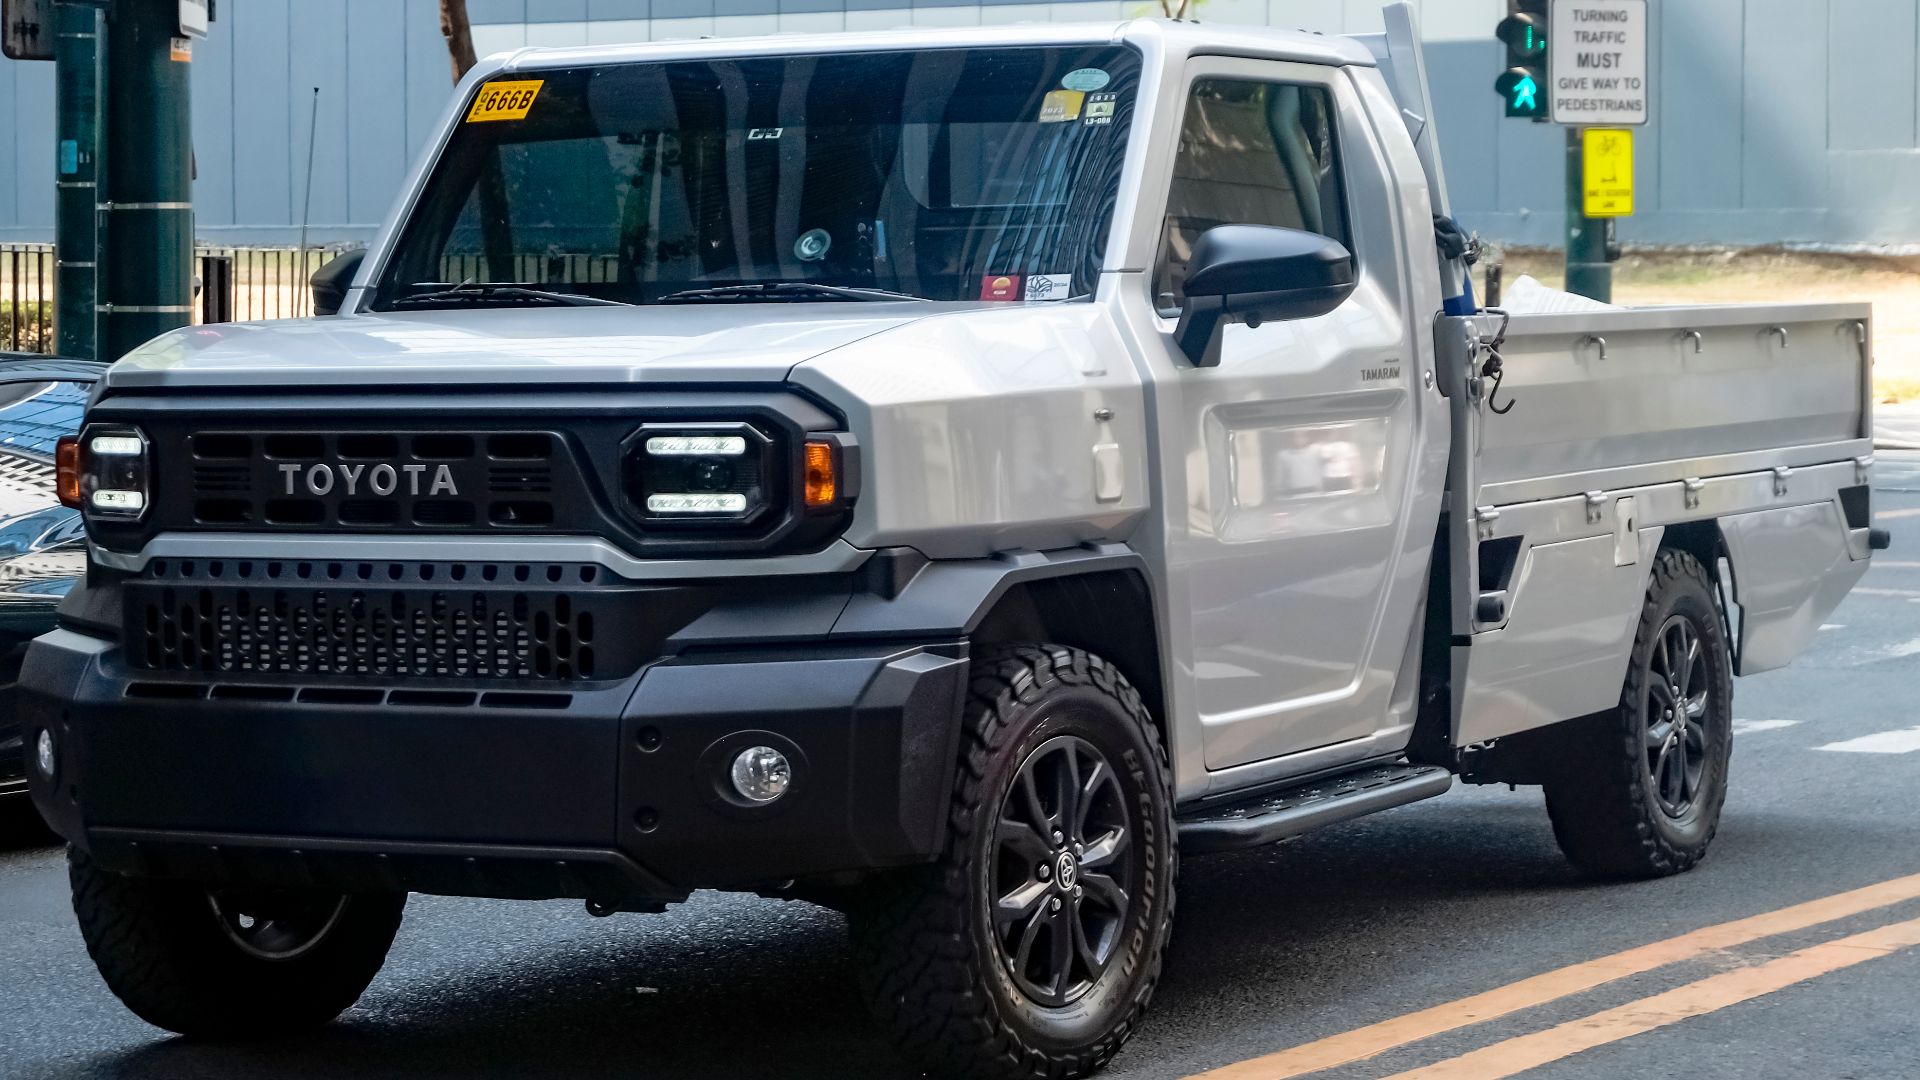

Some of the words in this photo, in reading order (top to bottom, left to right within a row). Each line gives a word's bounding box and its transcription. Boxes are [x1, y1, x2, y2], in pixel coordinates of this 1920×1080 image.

[1572, 9, 1629, 23] TURNING
[1574, 31, 1627, 44] TRAFFIC
[1576, 52, 1622, 68] MUST
[1558, 77, 1589, 90] GIVE
[1593, 77, 1620, 90] WAY
[1624, 77, 1641, 90] TO
[485, 89, 534, 112] 666B
[1557, 98, 1642, 112] PEDESTRIANS
[1360, 366, 1401, 381] TAMARAW
[278, 463, 459, 496] TOYOTA
